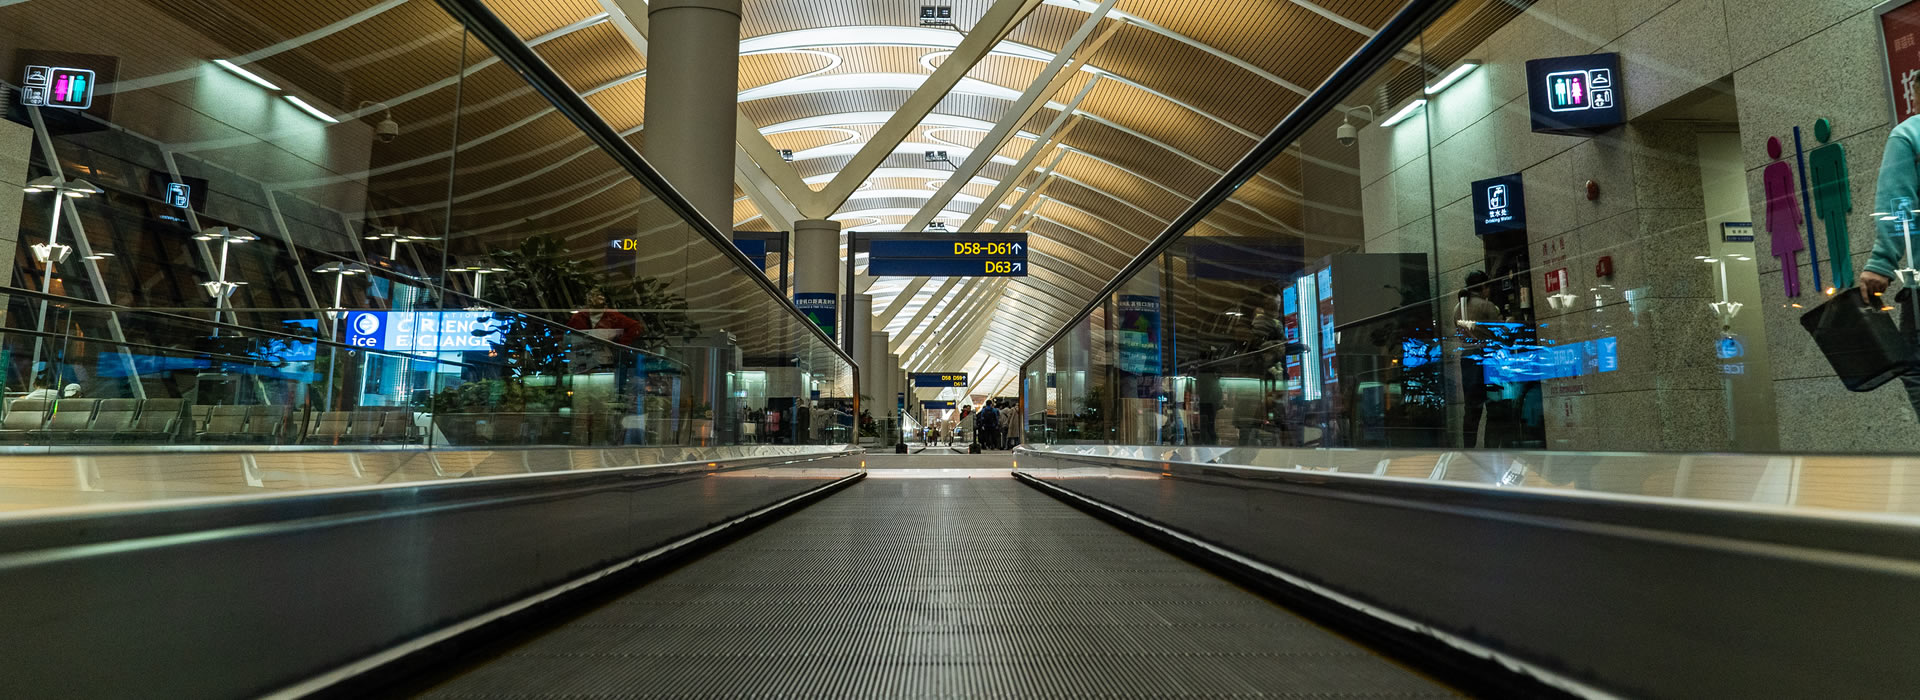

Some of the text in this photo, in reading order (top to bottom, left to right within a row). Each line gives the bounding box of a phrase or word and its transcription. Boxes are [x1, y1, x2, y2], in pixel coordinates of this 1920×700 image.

[1485, 216, 1500, 224] Drinking
[985, 261, 1011, 273] D63
[397, 318, 492, 333] CRENCY
[351, 335, 377, 347] ice
[395, 334, 491, 346] ECANGE
